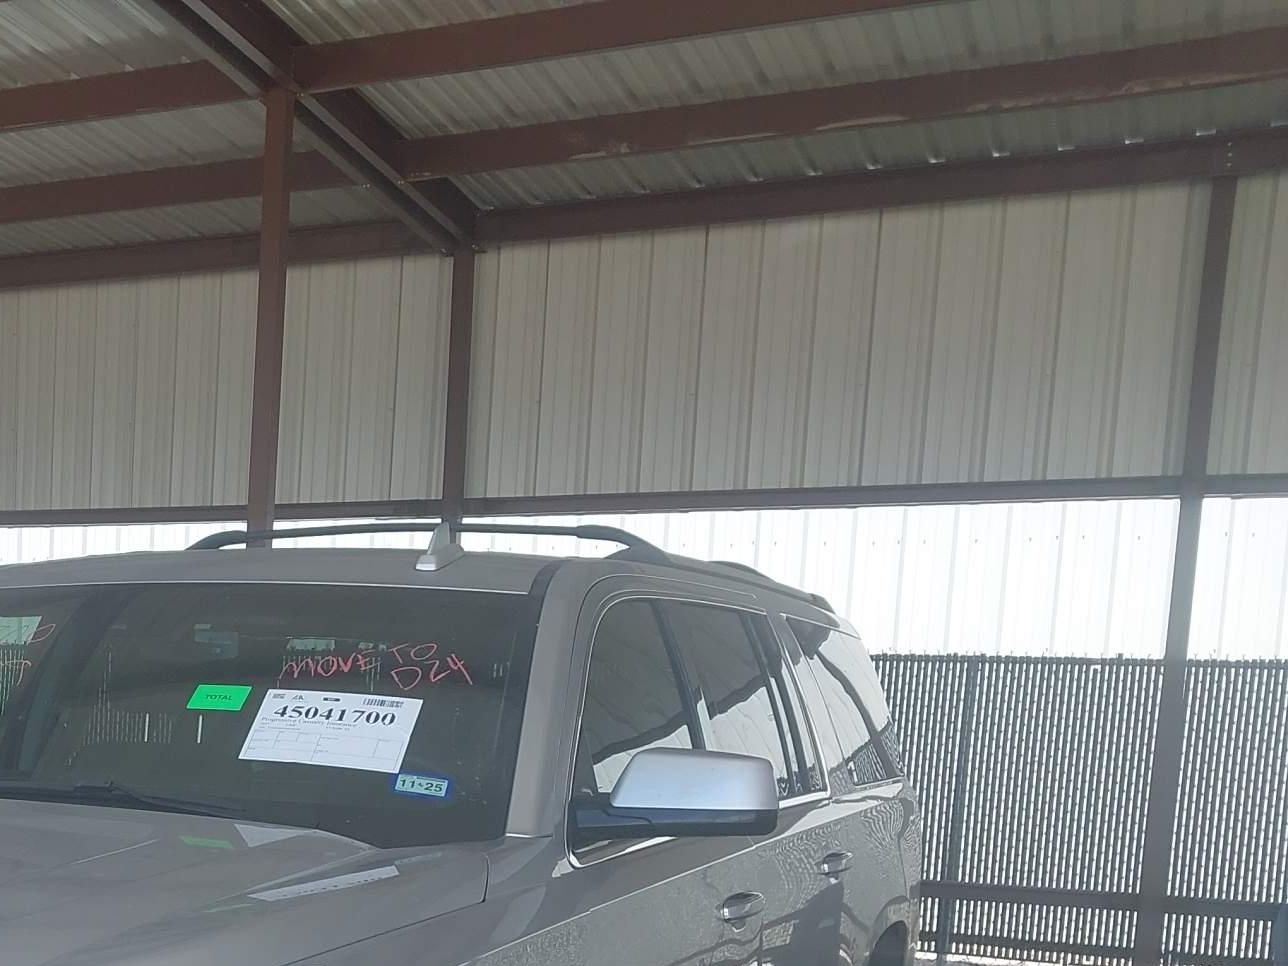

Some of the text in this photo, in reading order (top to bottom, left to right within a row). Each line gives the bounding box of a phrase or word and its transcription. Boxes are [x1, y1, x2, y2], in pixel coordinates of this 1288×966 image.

[279, 643, 438, 680] MOVE TO
[390, 653, 473, 691] D24
[273, 704, 396, 726] 45041700
